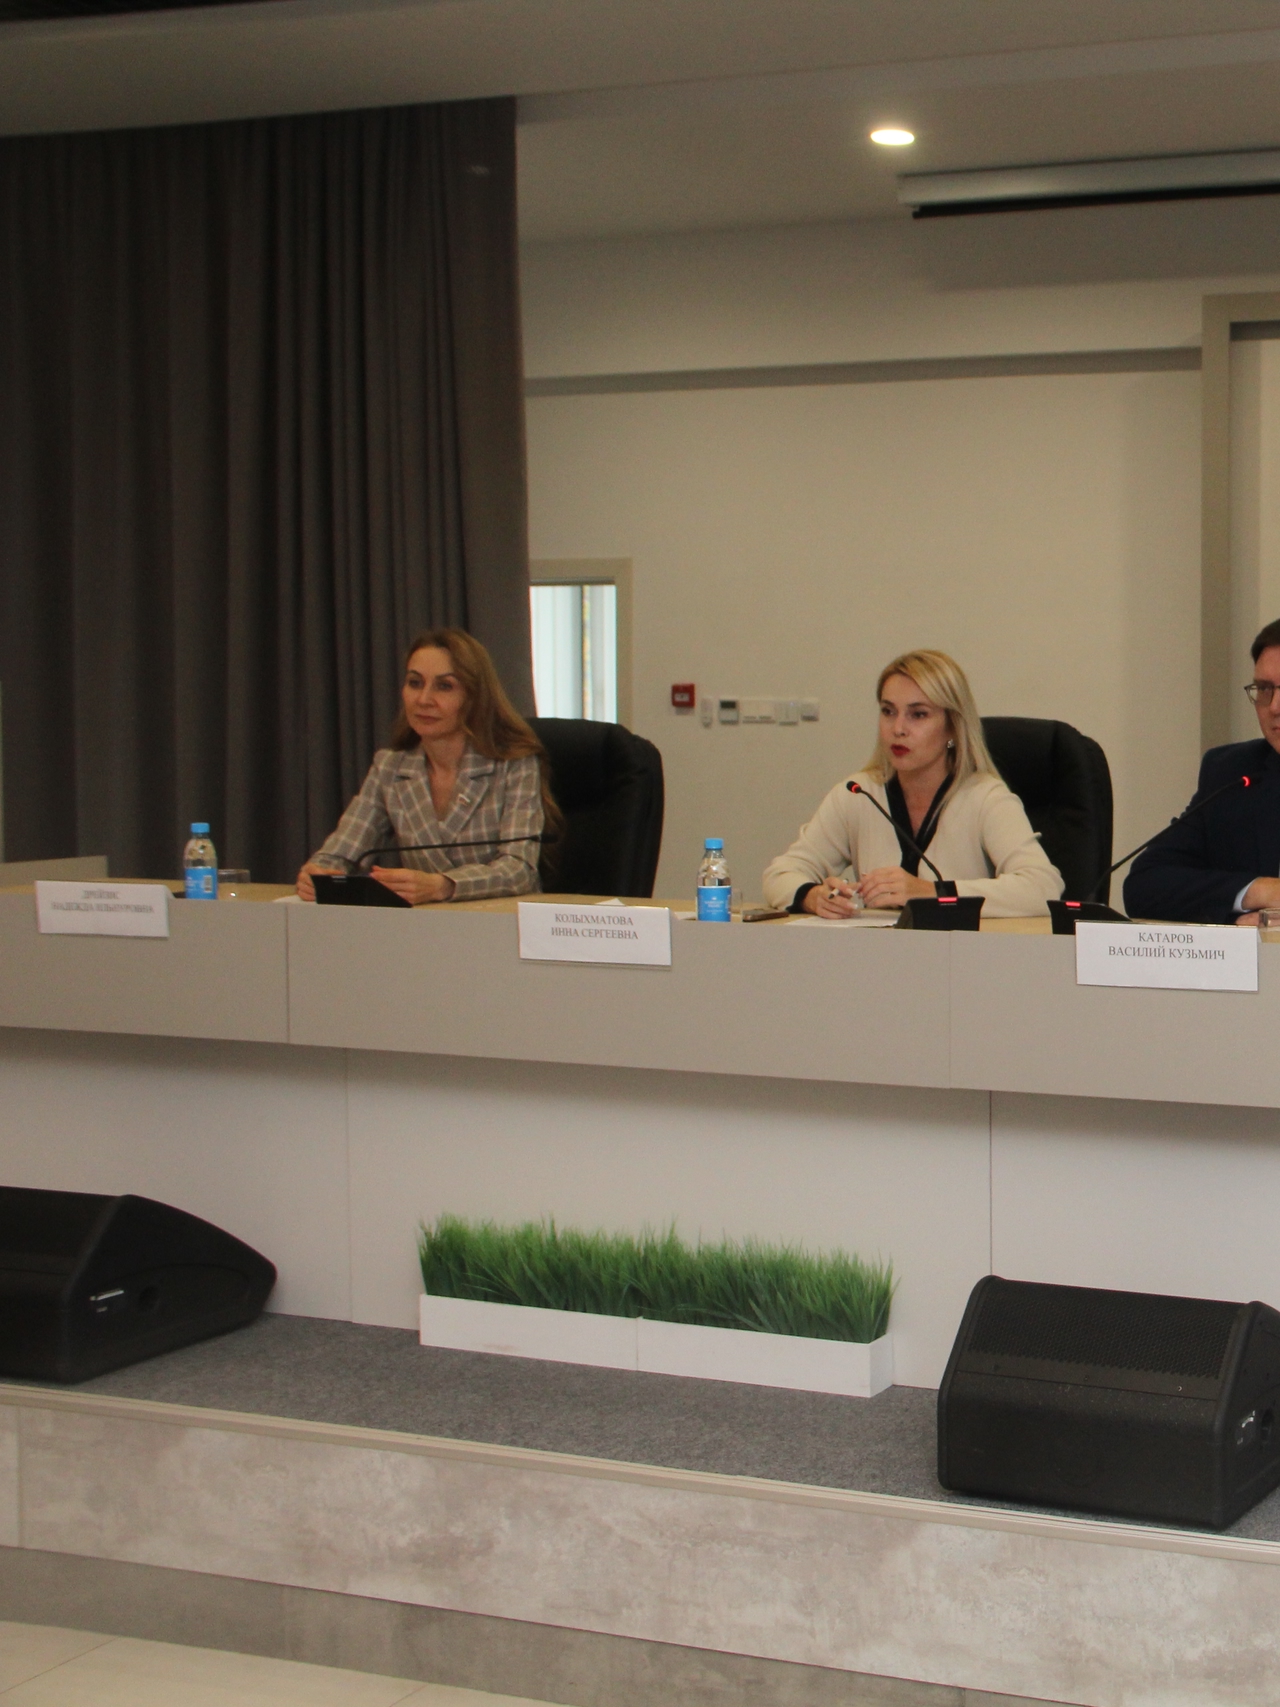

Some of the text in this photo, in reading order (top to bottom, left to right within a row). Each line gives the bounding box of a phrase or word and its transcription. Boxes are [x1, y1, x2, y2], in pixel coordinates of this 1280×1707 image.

[554, 913, 634, 926] КОЛЫХМАТОВА
[551, 926, 639, 940] ИННА СЕРГЕЕВНА
[1138, 932, 1194, 944] КАТАРОВ
[1108, 945, 1225, 960] ВАСИЛИЙ КУЗЬМИЧ
